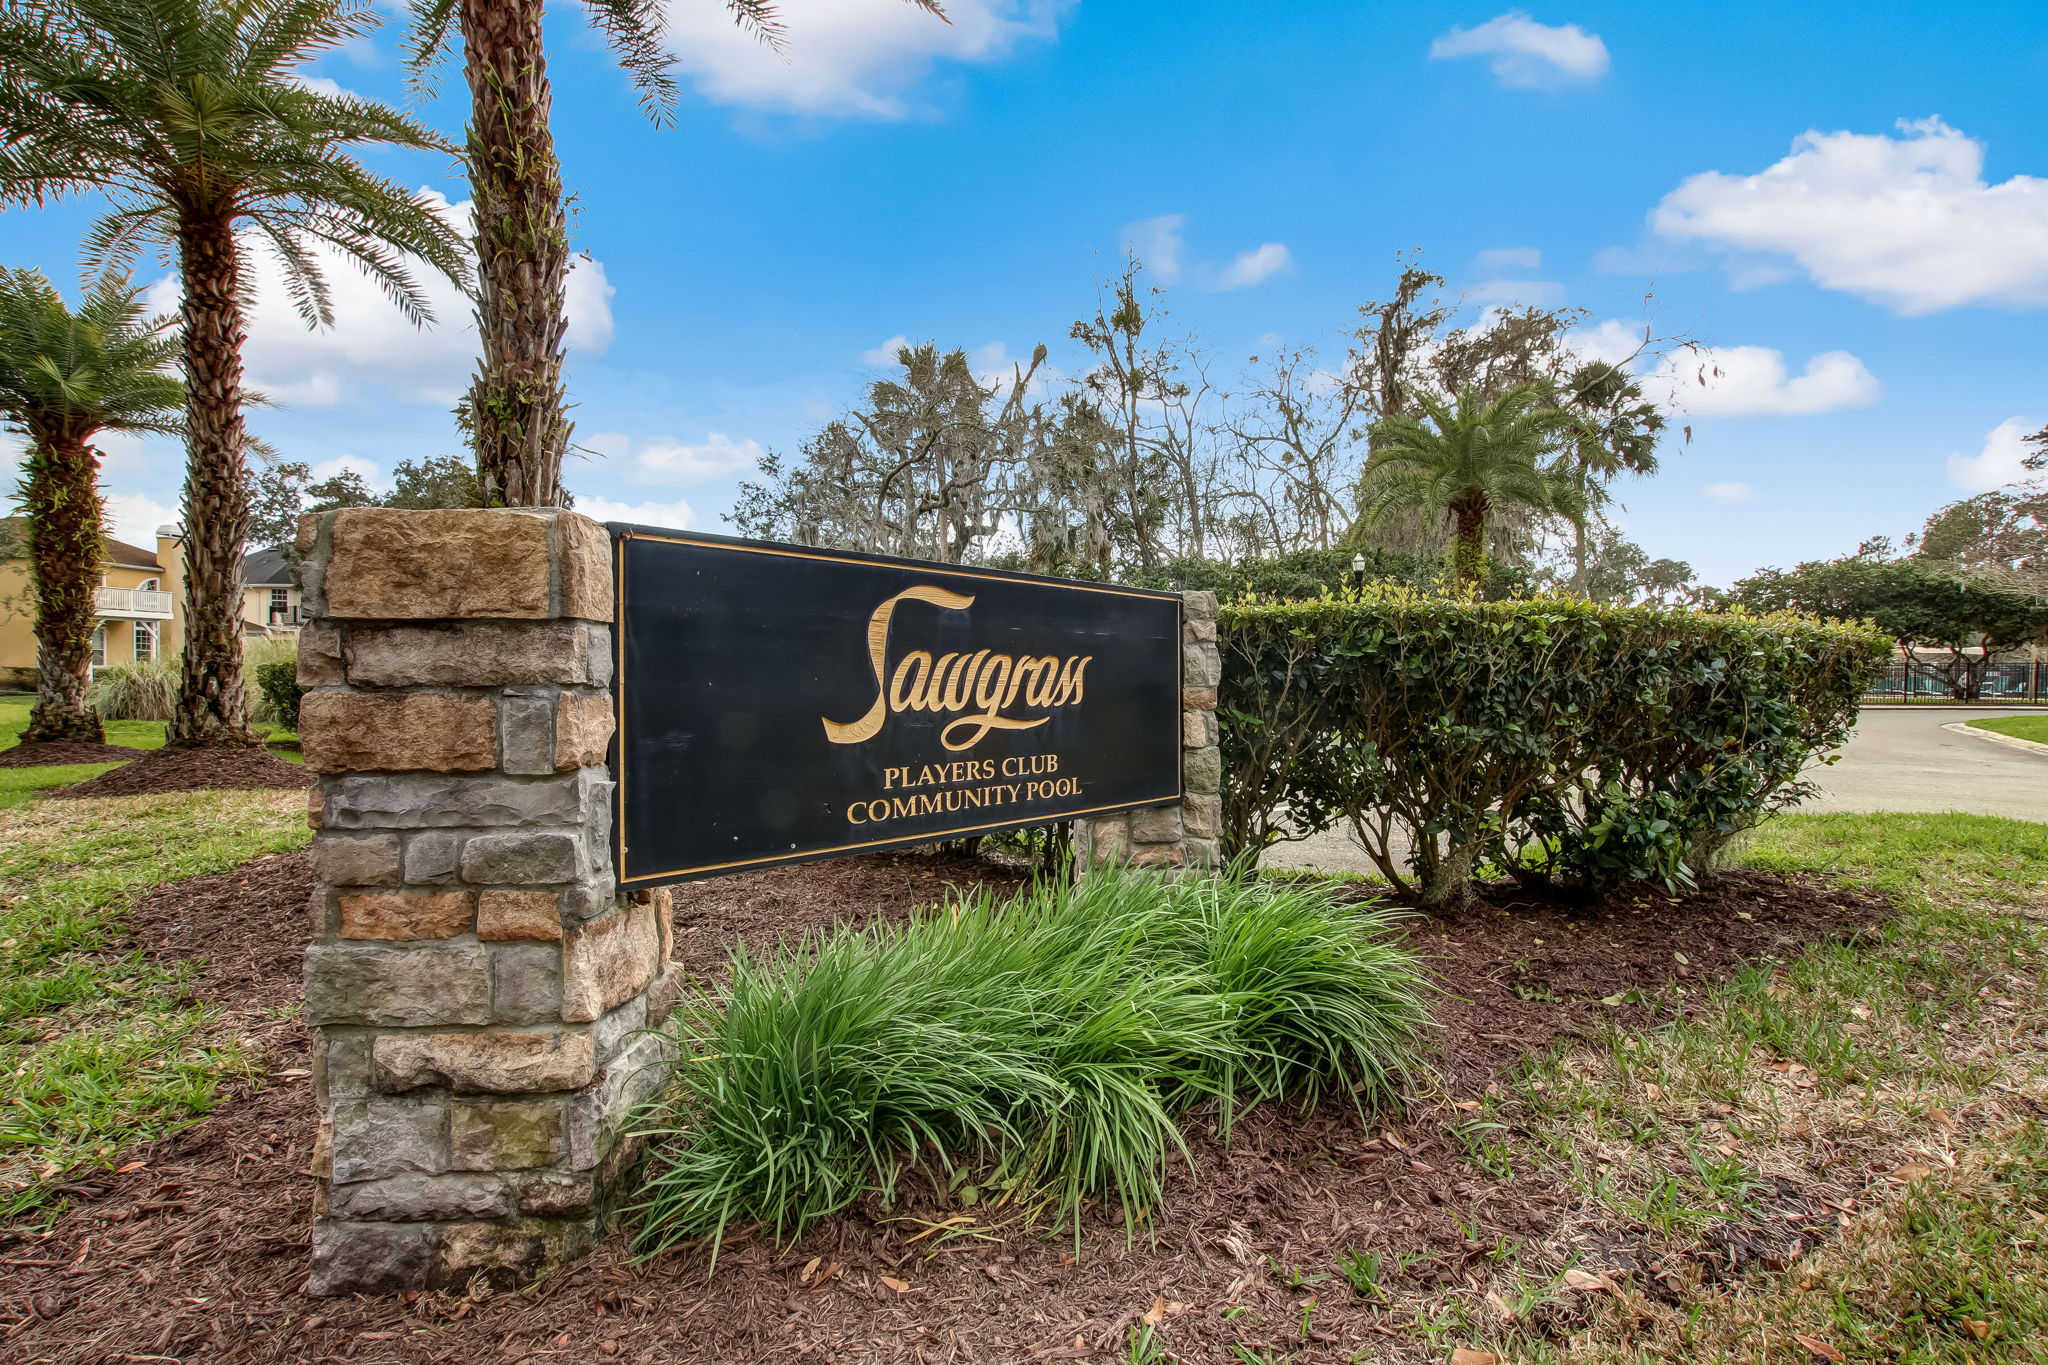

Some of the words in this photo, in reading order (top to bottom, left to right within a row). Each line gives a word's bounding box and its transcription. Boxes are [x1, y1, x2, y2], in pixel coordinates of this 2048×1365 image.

[822, 585, 1092, 751] Sawgrass
[884, 760, 995, 789] PLAYERS
[1002, 754, 1058, 777] CLUB
[847, 785, 1021, 824] COMMUNITY
[1027, 777, 1082, 801] POOL
